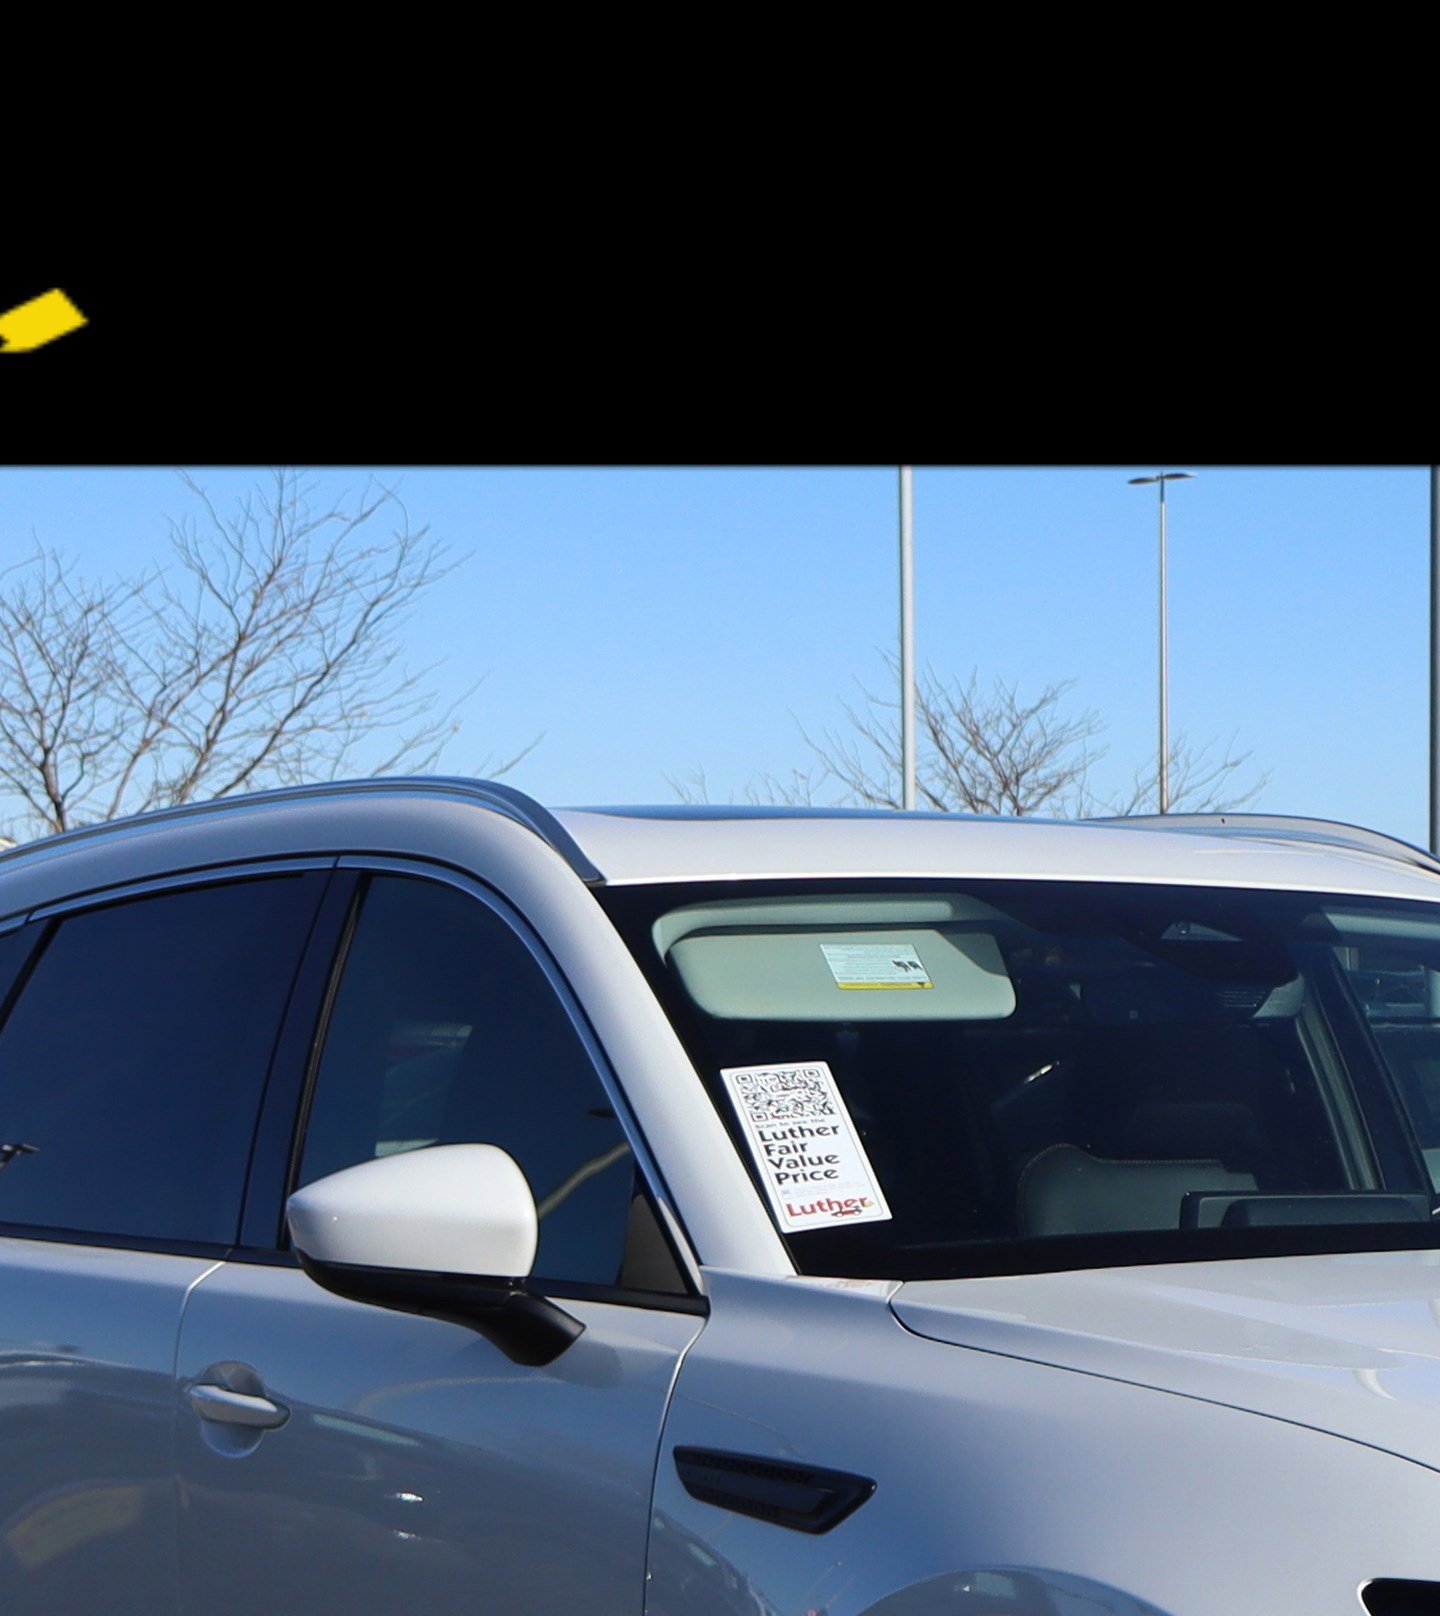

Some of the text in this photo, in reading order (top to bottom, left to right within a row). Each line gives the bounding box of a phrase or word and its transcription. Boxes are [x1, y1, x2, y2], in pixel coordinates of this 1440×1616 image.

[758, 1125, 839, 1142] Luther
[763, 1141, 808, 1157] Fair
[768, 1154, 840, 1170] Value
[775, 1169, 839, 1185] Price
[786, 1197, 868, 1217] Luther
